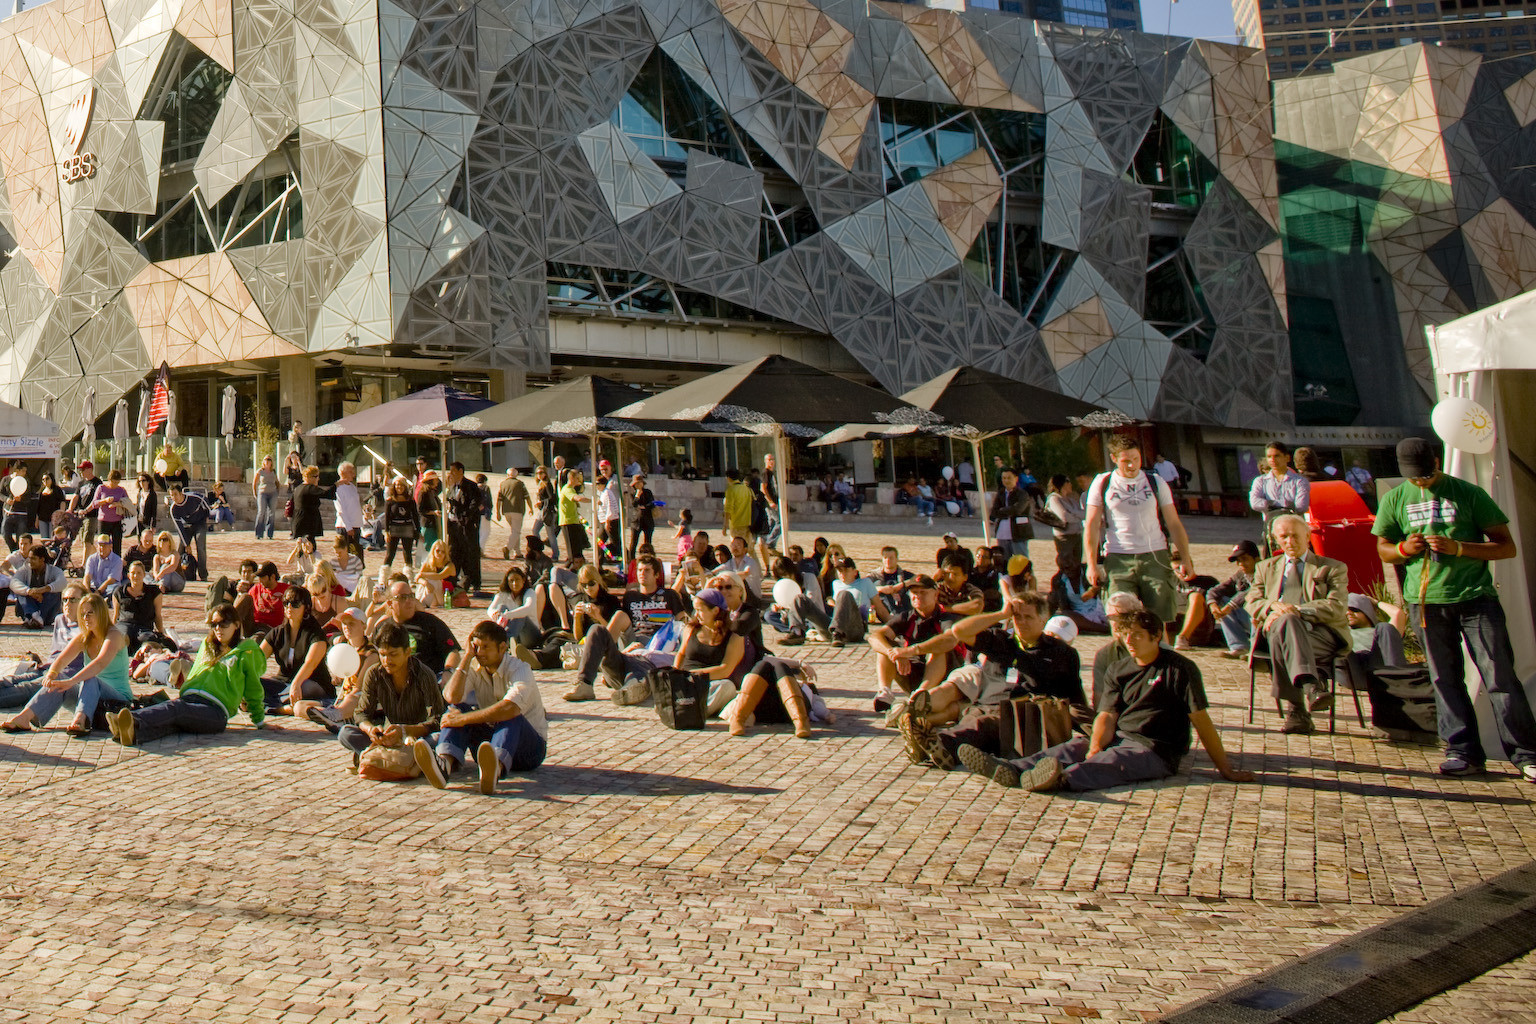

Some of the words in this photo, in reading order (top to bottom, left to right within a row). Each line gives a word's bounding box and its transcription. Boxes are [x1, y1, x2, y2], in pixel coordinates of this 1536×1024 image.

[61, 152, 92, 182] SBS
[21, 436, 44, 447] Sizzle
[1126, 483, 1136, 492] N
